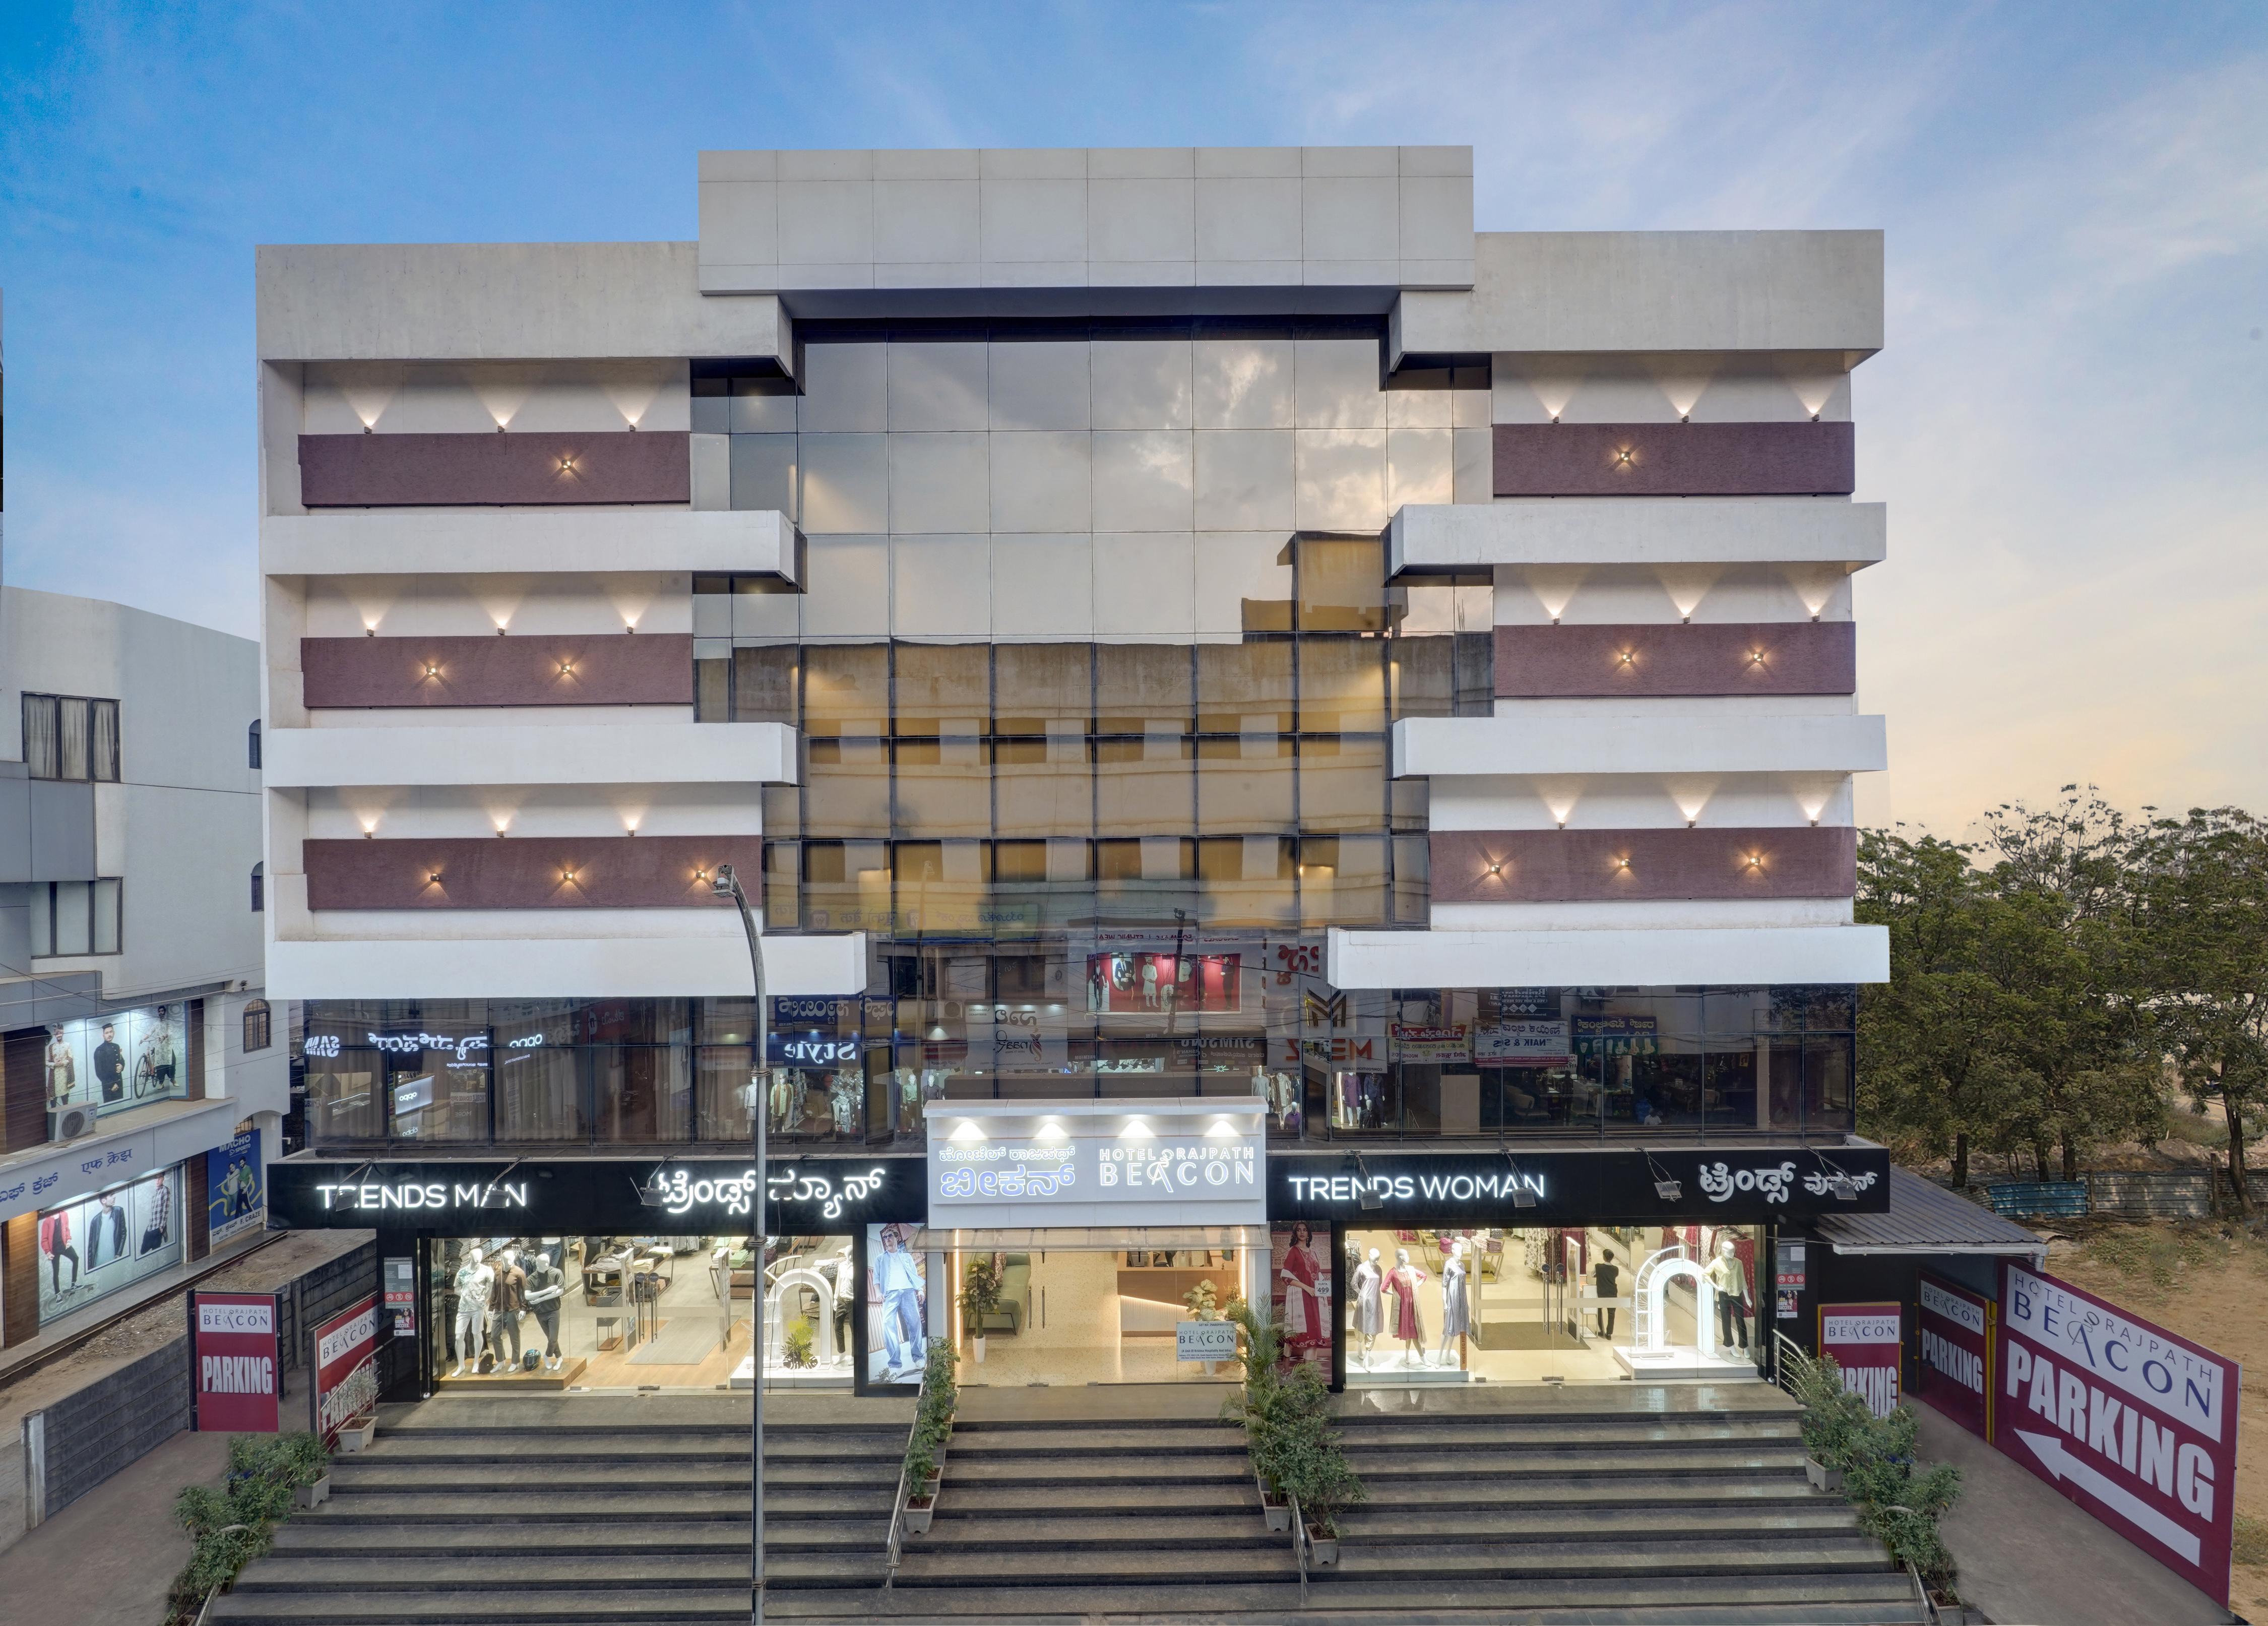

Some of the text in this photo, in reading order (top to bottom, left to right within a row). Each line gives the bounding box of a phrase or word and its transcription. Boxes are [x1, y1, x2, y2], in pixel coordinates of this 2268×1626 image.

[219, 1134, 251, 1153] MACHO
[1100, 1146, 1253, 1161] HOTEL RAJPATH
[940, 1162, 1075, 1198] ಬೀಕನ್
[1099, 1160, 1254, 1193] BEACON
[1288, 1174, 1545, 1201] TRENDS WOMAN
[245, 1210, 261, 1222] CRAZE
[1924, 1285, 1980, 1315] HOTEL RAJPATH
[1924, 1291, 1980, 1327] BEACON
[203, 1315, 268, 1329] BEACON
[323, 1311, 375, 1347] HOTEL RAJPATH
[323, 1317, 375, 1360] BEACON
[1829, 1326, 1895, 1340] BEACON
[2015, 1273, 2213, 1383] HOTEL RAJPATH
[1179, 1335, 1234, 1346] BEACON
[2014, 1289, 2211, 1419] BEACON
[202, 1355, 273, 1395] PARKING
[1922, 1328, 1983, 1395] PARKING
[2006, 1339, 2215, 1524] PARKING
